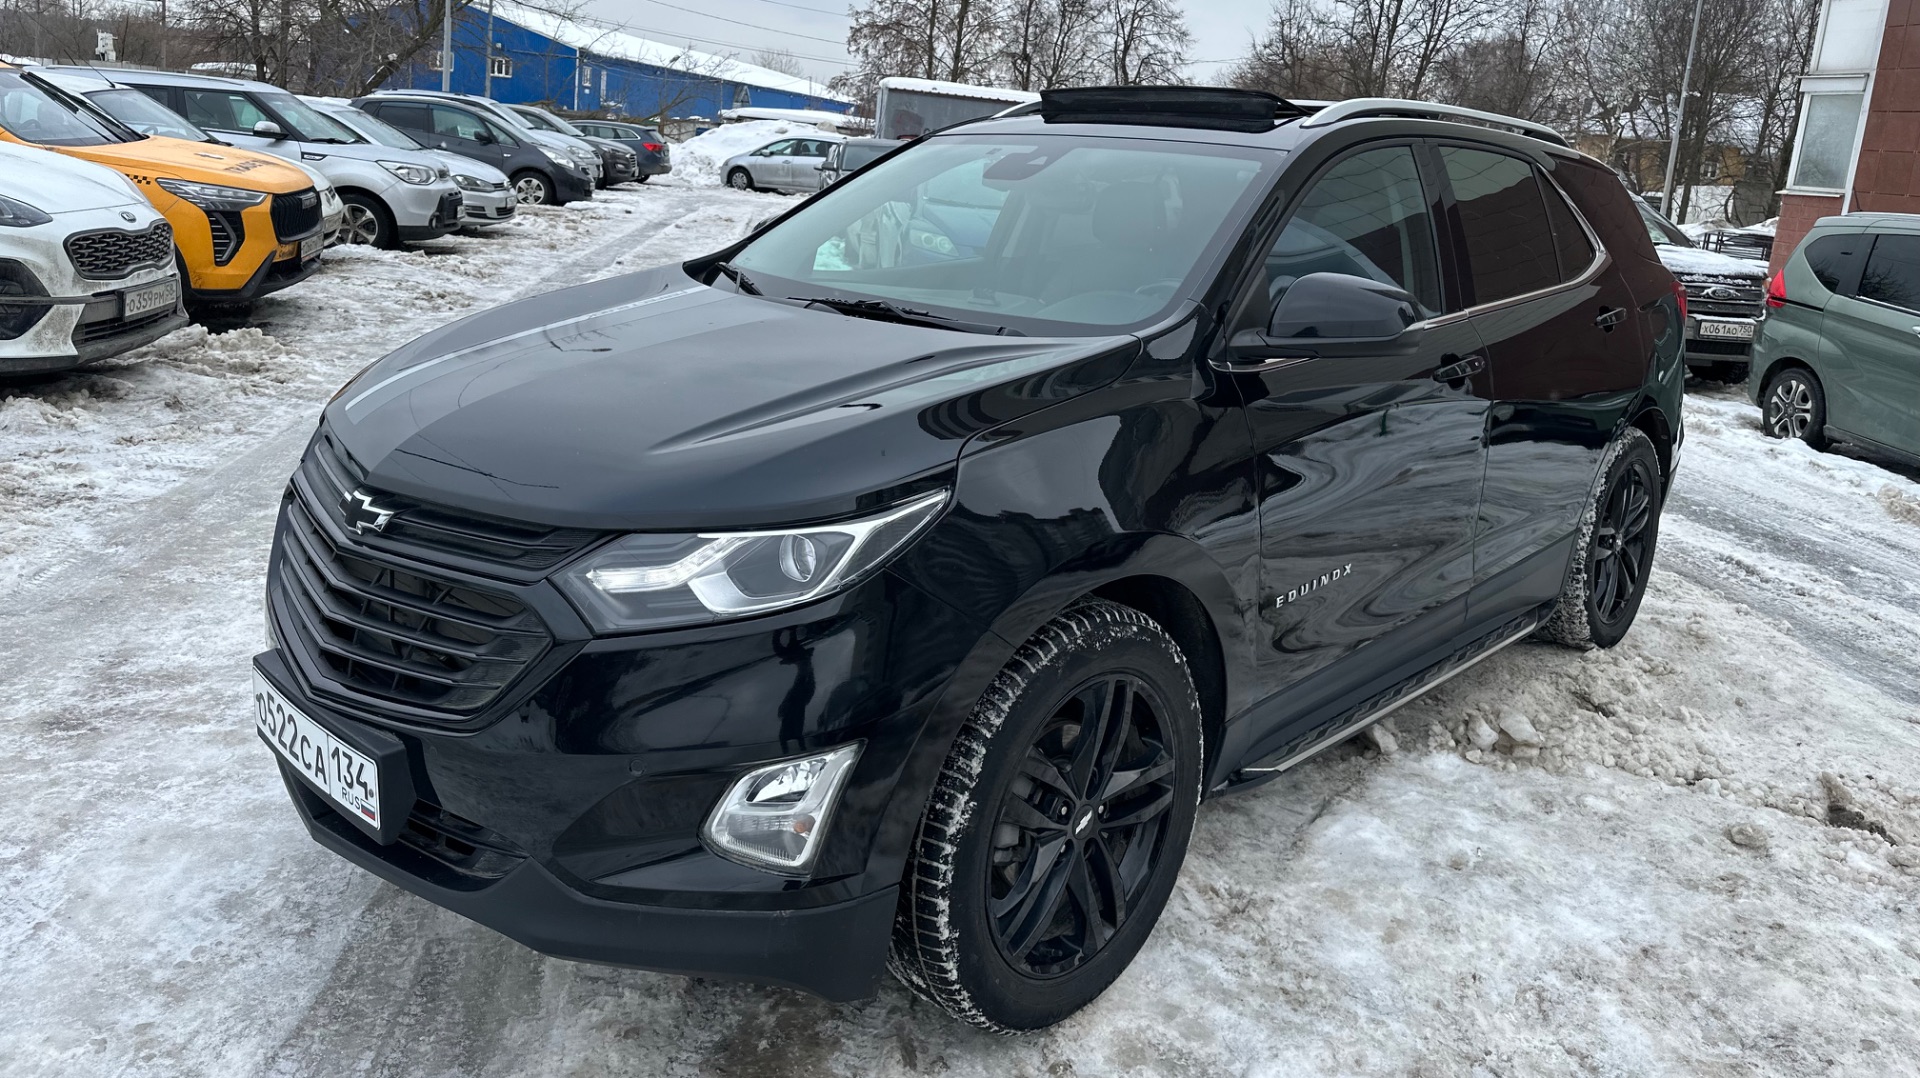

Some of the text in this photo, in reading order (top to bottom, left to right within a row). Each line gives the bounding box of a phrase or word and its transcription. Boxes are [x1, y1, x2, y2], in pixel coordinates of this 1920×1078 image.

[1275, 563, 1352, 608] EQUINOX
[256, 690, 369, 800] О522СА 134
[341, 786, 361, 810] RUS
